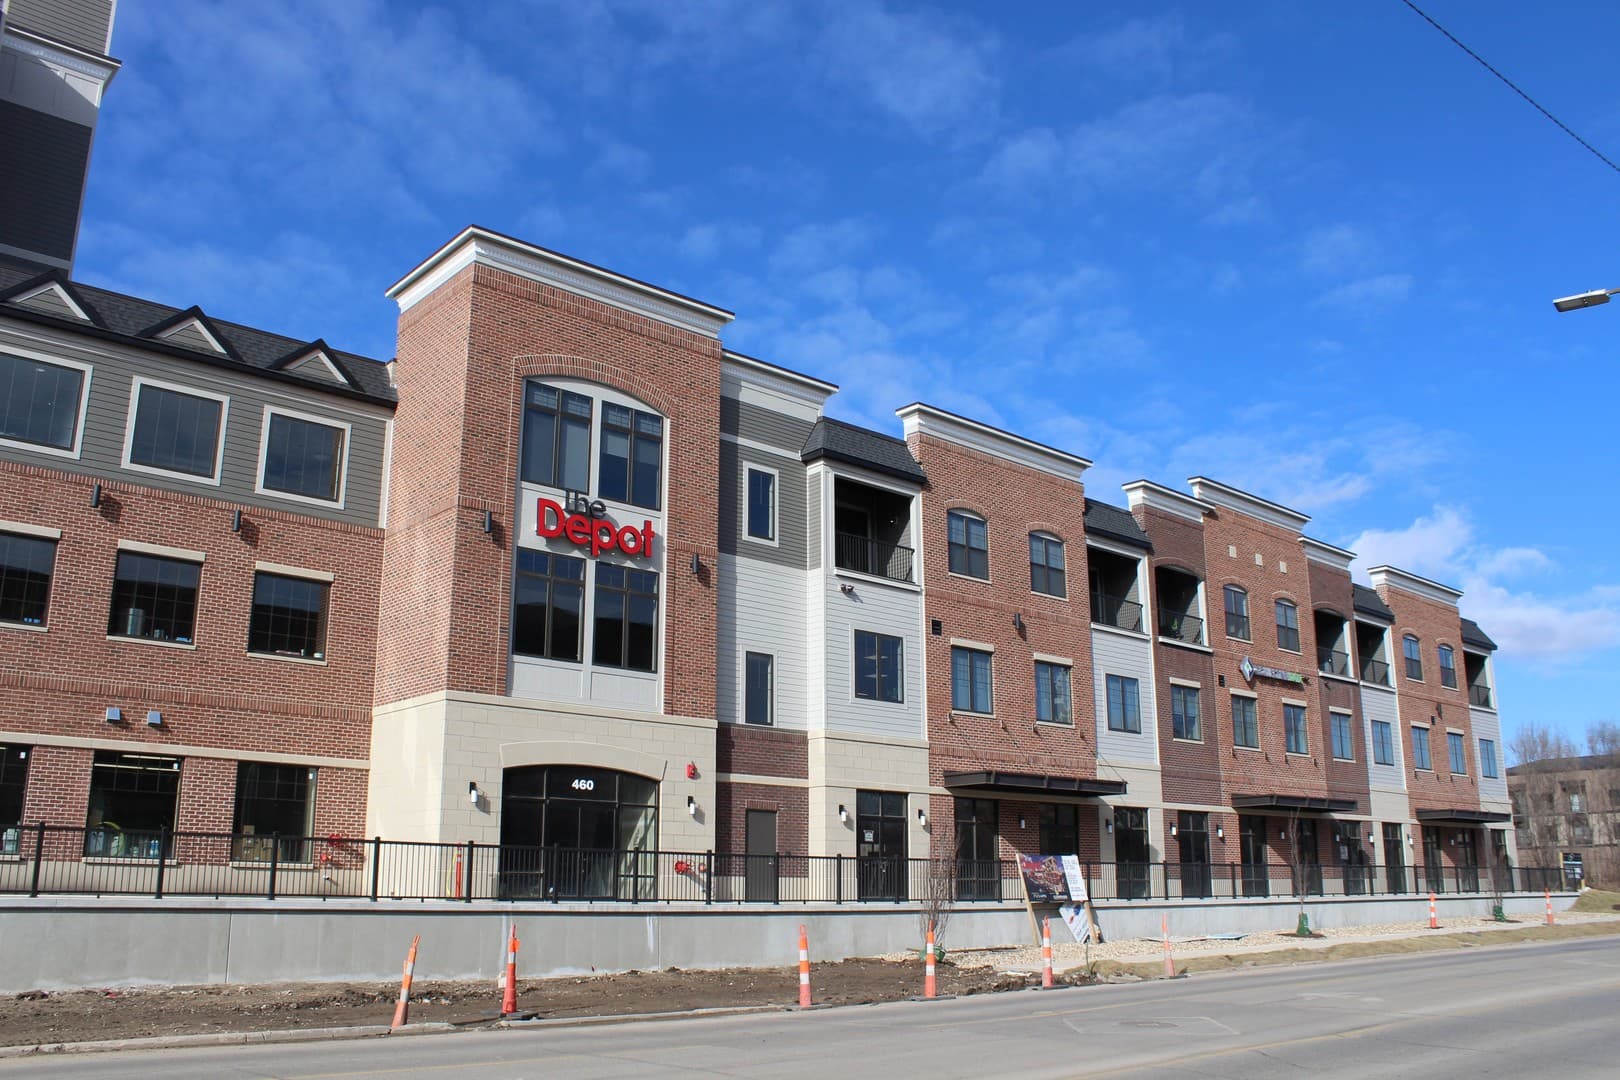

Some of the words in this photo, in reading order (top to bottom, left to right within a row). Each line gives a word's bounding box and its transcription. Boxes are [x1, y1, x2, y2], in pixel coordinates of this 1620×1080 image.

[565, 488, 607, 519] the
[536, 497, 655, 558] Depot
[571, 778, 595, 791] 460
